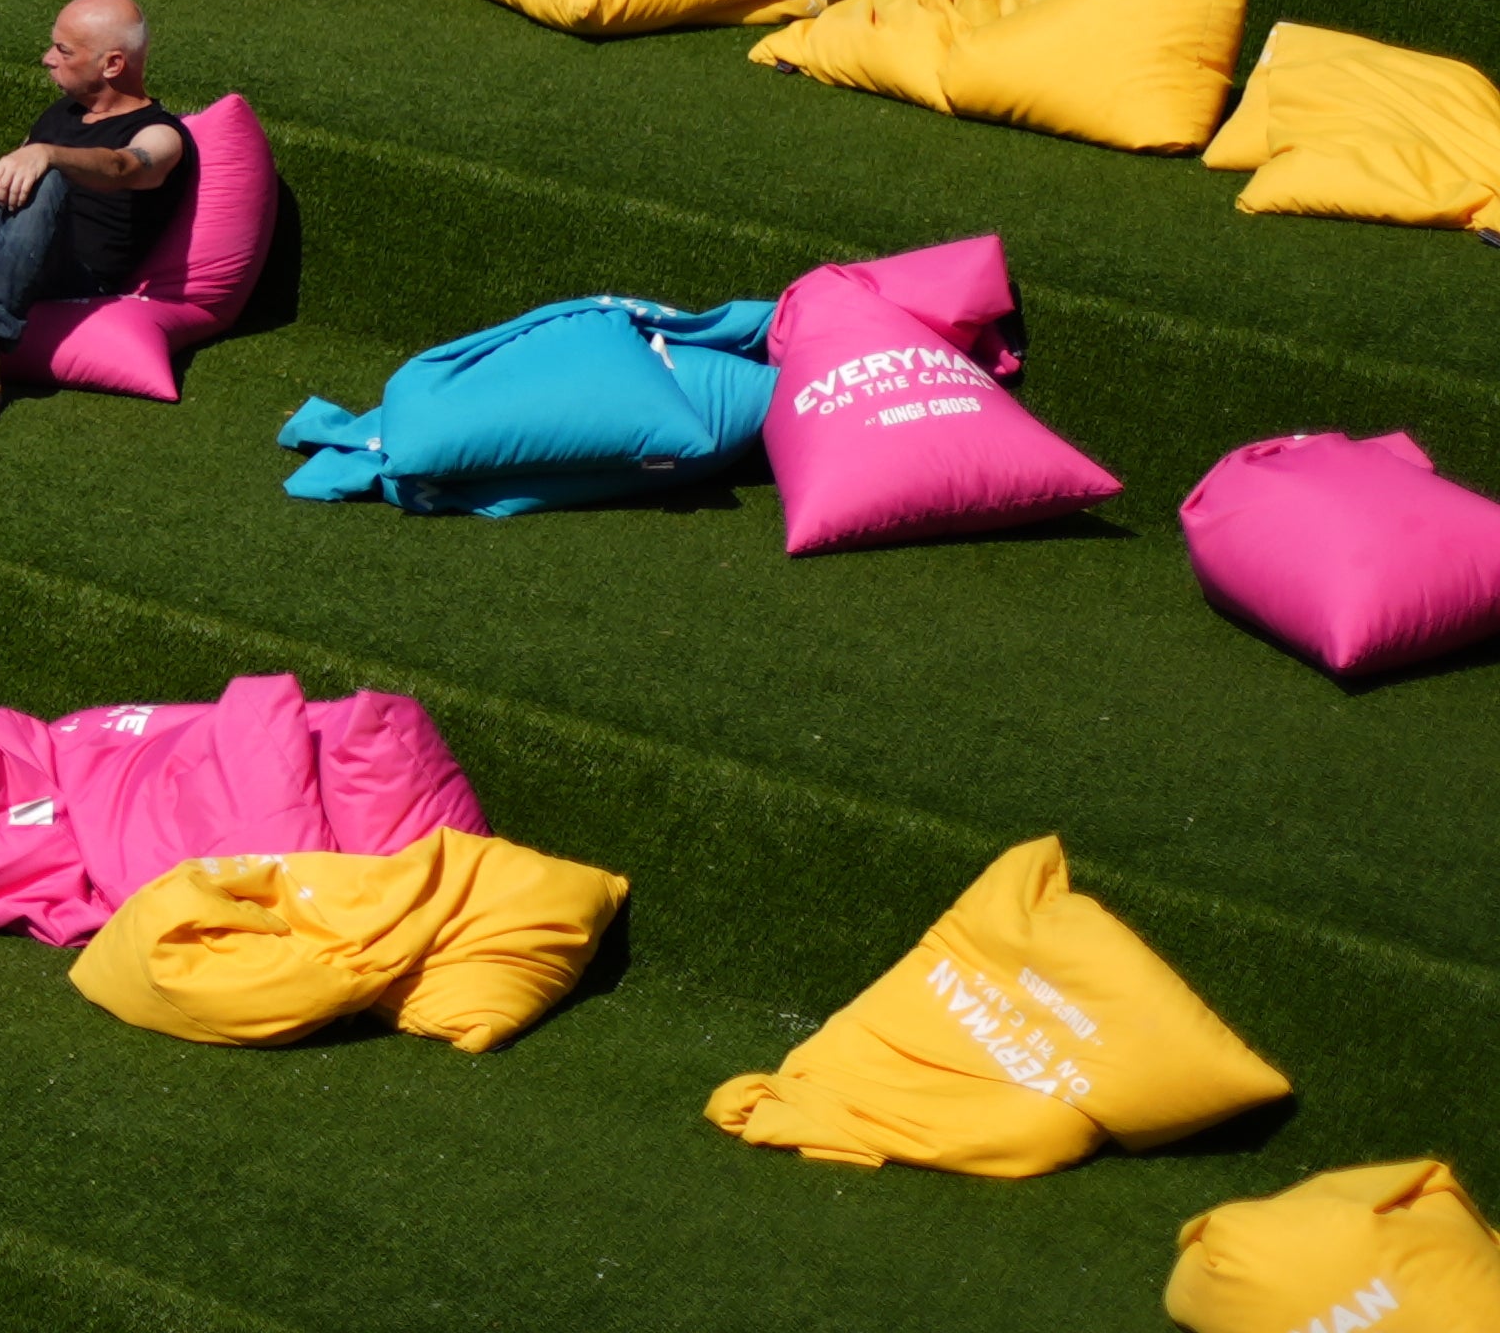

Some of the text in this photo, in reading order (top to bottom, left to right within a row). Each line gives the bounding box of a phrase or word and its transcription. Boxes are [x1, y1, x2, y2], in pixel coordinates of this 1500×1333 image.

[794, 347, 994, 416] EVERYMAN
[819, 371, 994, 415] ON THE CANAL
[878, 401, 927, 426] KINGS
[928, 396, 982, 416] CROSS
[927, 959, 1060, 1096] VERYMAN
[1056, 1060, 1090, 1095] ON
